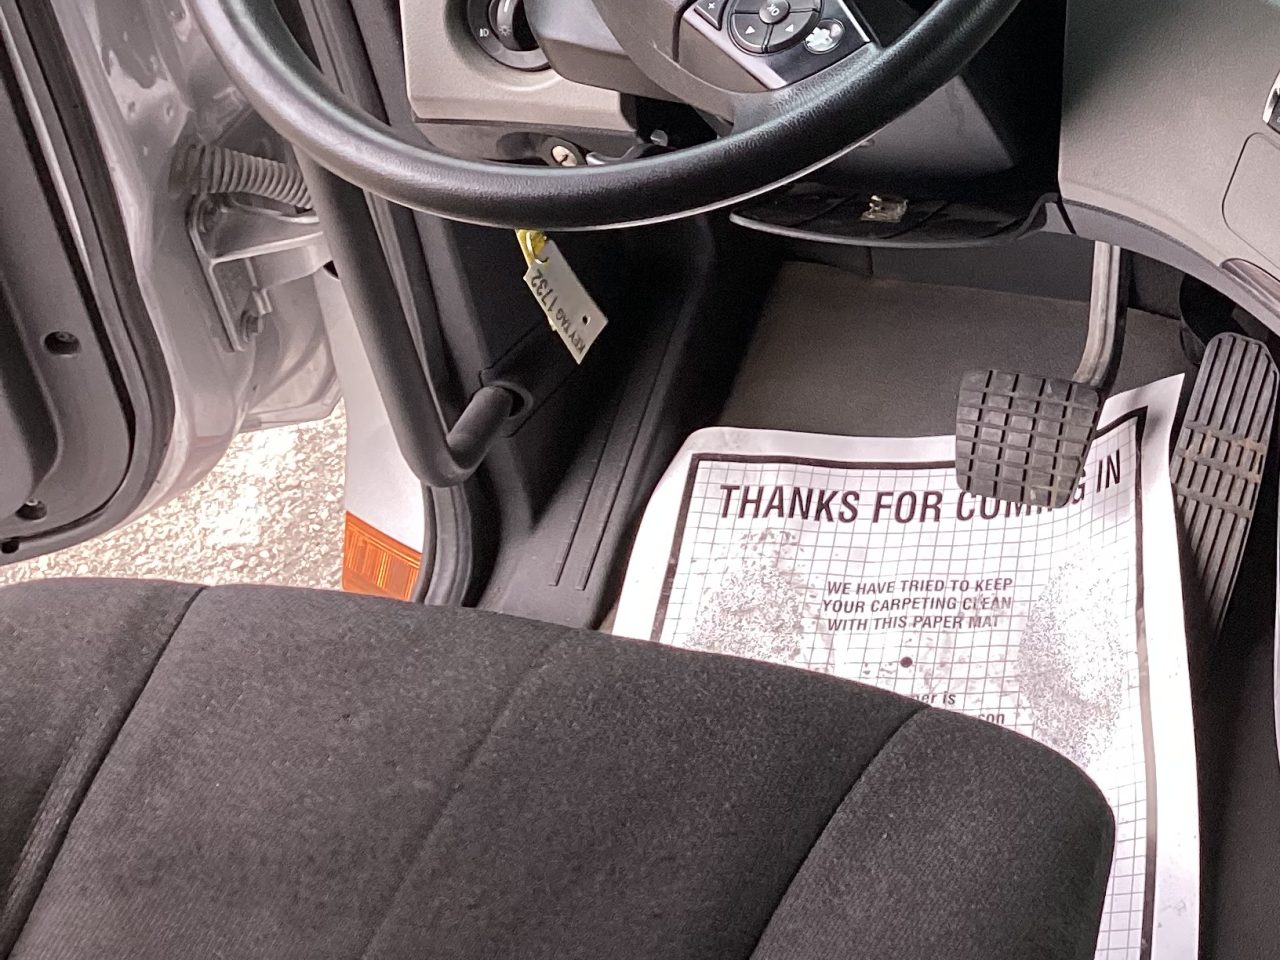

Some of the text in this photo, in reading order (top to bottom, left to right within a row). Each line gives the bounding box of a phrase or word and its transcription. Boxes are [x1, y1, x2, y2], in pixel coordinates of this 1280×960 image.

[767, 3, 780, 17] OK
[530, 268, 586, 355] KEY TAG 1732
[719, 484, 861, 524] THANKS
[871, 490, 944, 524] FOR
[1096, 448, 1122, 493] IN
[827, 577, 1013, 596] WE HAVE TRIED TO KEEP
[821, 596, 1012, 614] YOUR CARPETING CLEAN
[827, 615, 1002, 632] WITH THIS PAPER MAT
[942, 690, 957, 706] is
